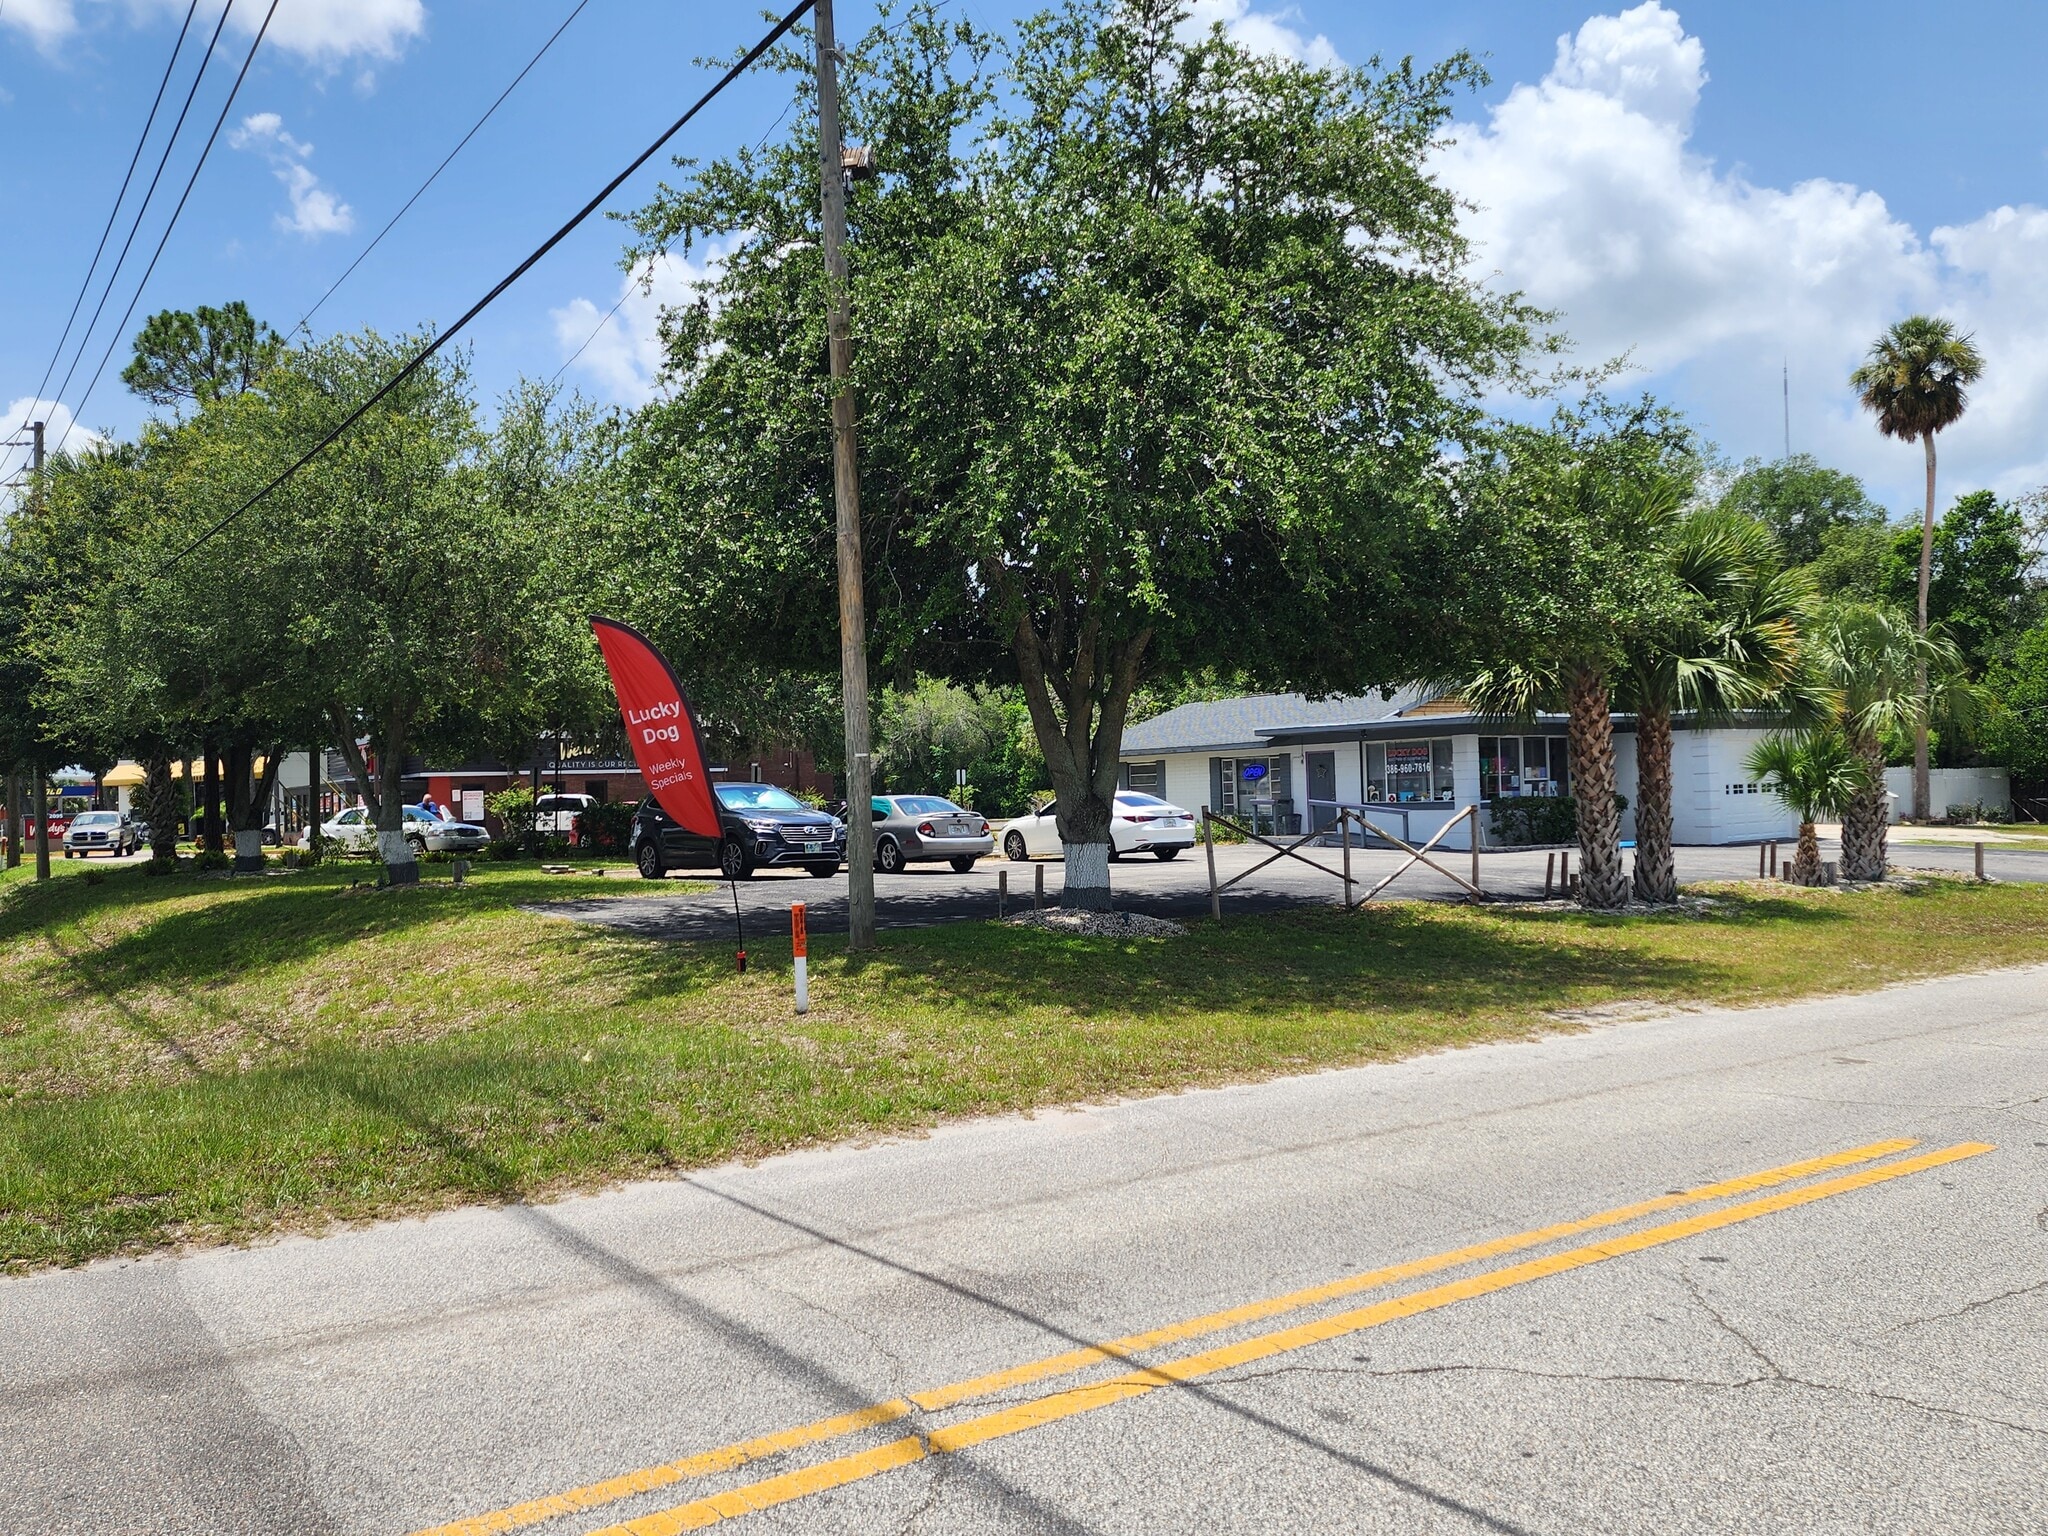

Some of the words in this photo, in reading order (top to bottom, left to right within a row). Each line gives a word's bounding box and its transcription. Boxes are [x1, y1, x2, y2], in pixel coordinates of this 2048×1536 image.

[628, 700, 680, 725] Lucky
[642, 725, 680, 745] Dog
[1387, 748, 1410, 757] LUCKY
[1411, 747, 1428, 756] DOG
[648, 758, 686, 775] Weekly
[1244, 767, 1263, 777] OPEN
[651, 771, 693, 790] Specials
[29, 822, 66, 837] Wdy's
